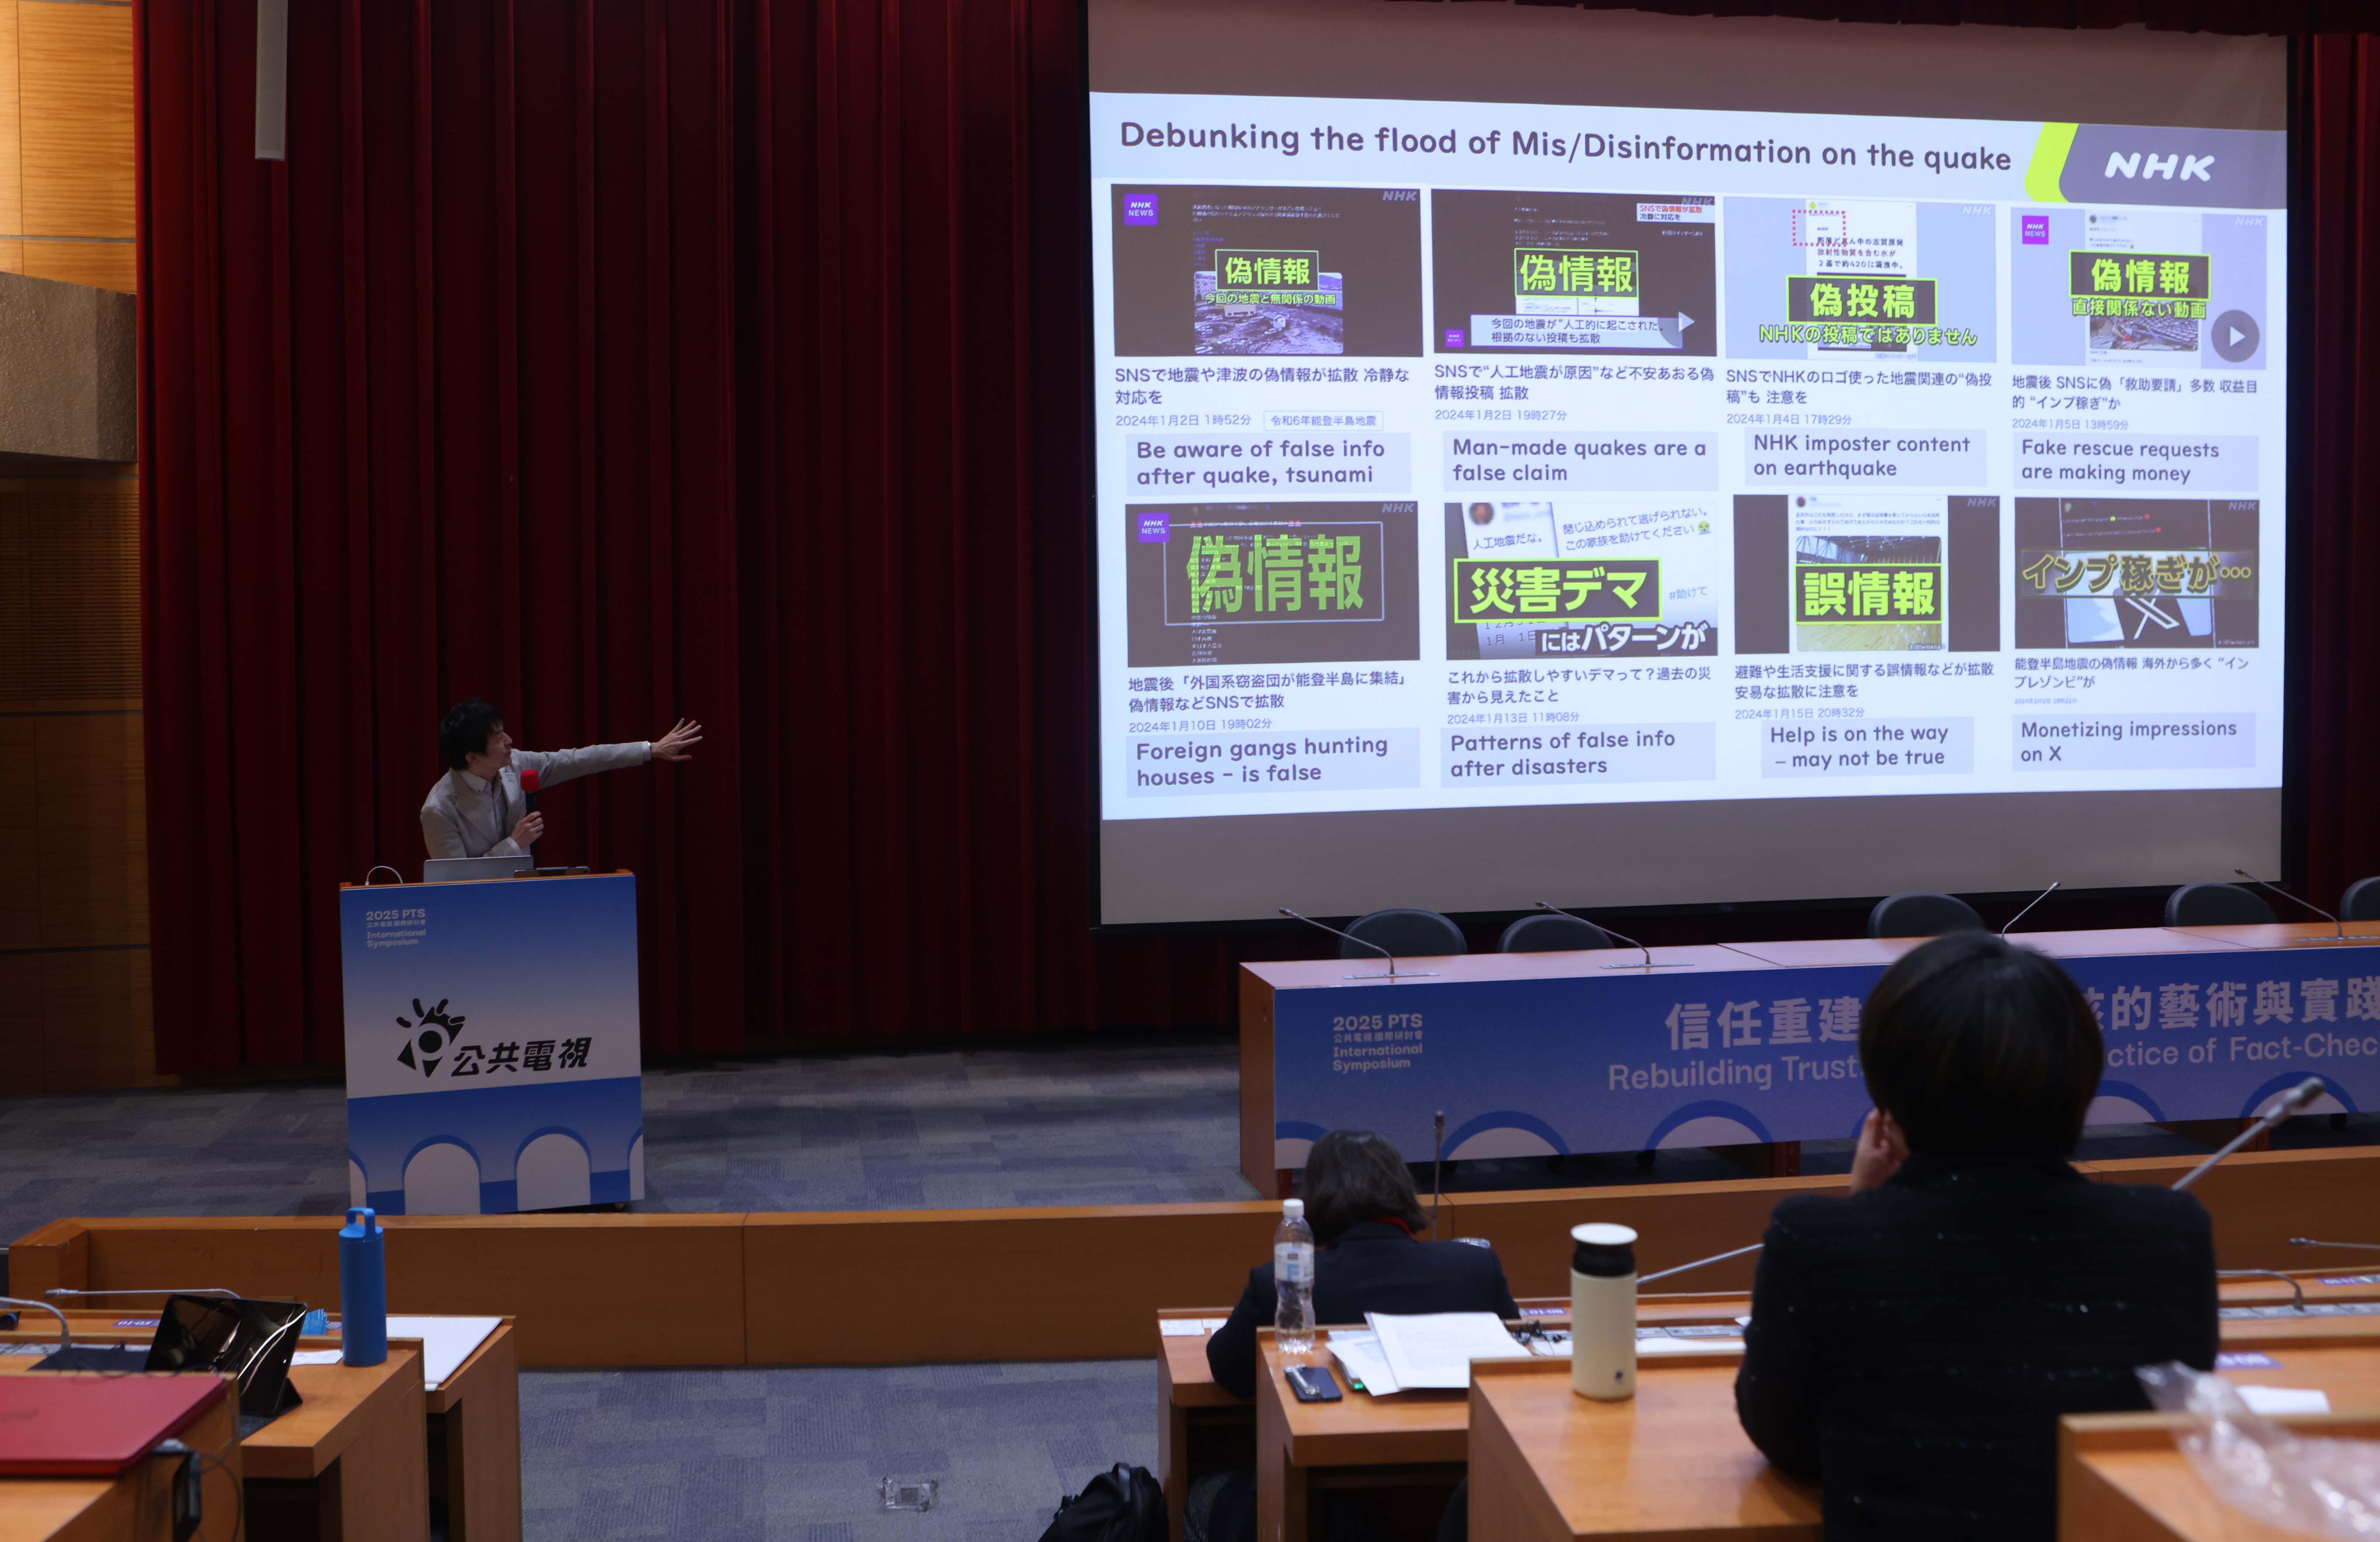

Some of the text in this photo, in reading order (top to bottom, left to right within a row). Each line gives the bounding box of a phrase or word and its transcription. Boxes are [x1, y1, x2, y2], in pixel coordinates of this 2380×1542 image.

[1122, 122, 2011, 174] Debunking the flood of Mis/Disinformation on the quake
[2105, 152, 2215, 181] NHK
[1383, 191, 1416, 201] NHK
[1963, 206, 1993, 216] NHK
[1225, 257, 1310, 285] 偽情報
[1520, 254, 1633, 293] 偽情報
[2092, 259, 2189, 293] 偽情報
[1205, 293, 1336, 305] 今回の地震と無関係の動画
[1810, 283, 1914, 318] 偽投稿
[2072, 298, 2207, 319] 直接関係ない動画
[1491, 333, 1600, 344] 根拠のない投稿も拡散
[1760, 325, 1978, 345] NHKの投稿ではありません
[1115, 368, 1409, 382] SNSで地震や津波の偽情報が拡散 冷静な
[2013, 375, 2051, 389] 地震後
[2191, 379, 2214, 392] 多数
[2220, 380, 2257, 393] 収益目
[1115, 390, 1162, 405] 対応を
[1435, 386, 1528, 400] 情報投稿 拡散
[1767, 390, 1807, 404] 注意を
[2013, 396, 2024, 408] 的
[1116, 415, 1252, 426] 2024年1月2日 1時52分
[1271, 416, 1376, 426] 令和6年能登半島地震
[1436, 410, 1566, 420] 2024年1月2日 19時27分
[1727, 414, 1852, 425] 2024年1月4日 17時29分
[2013, 419, 2128, 430] 2024年1月5日 13時59分
[1138, 440, 1384, 458] Be aware of false info
[1454, 439, 1705, 460] Man-made quakes are a
[1755, 434, 1970, 455] NHK imposter content
[2023, 440, 2219, 461] Fake rescue requests
[1137, 466, 1372, 488] after quake, tsunami
[1453, 464, 1567, 481] false claim
[1754, 460, 1897, 480] on earthquake
[2022, 464, 2190, 484] are making money
[1382, 503, 1414, 513] NHK
[1967, 497, 1997, 507] NHK
[2229, 501, 2257, 510] NHK
[1563, 508, 1708, 534] 閉じ込められて逃げられない。
[1473, 533, 1542, 549] 人工地震だな。
[1566, 525, 1694, 550] この家族を助けてください
[1187, 534, 1364, 613] 偽情報
[1470, 566, 1647, 614] 災害デマ
[1669, 586, 1707, 600] #助けて
[1804, 571, 1935, 616] 誤情報
[1542, 621, 1709, 652] にはパターンが
[1735, 662, 1994, 679] 避難や生活支援に関する誤情報などが拡散
[2015, 657, 2137, 670] 能登半島地震の偽情報
[2142, 657, 2212, 670] 海外から多く
[1448, 689, 1558, 705] 害から見えたこと
[1736, 684, 1858, 699] 安易な拡散に注意を
[1129, 694, 1284, 713] 偽情報などSNSで拡散
[1447, 712, 1579, 724] 2024年1月13日 11時08分
[1735, 708, 1864, 719] 2024年1月15日 20時32分
[1129, 719, 1272, 733] 2024年1月10日 19時02分
[2022, 720, 2236, 740] Monetizing impressions
[1452, 730, 1675, 751] Patterns of false info
[1771, 725, 1948, 747] Help is on the way
[1137, 736, 1387, 762] Foreign gangs hunting
[2021, 746, 2061, 761] on X
[1451, 759, 1607, 777] after disasters
[1793, 750, 1944, 770] may not be true
[1138, 764, 1321, 786] houses is false
[366, 908, 425, 921] 2025 PTS
[367, 929, 426, 939] International
[367, 938, 418, 948] Symposium
[1334, 1013, 1423, 1031] 2025 PTS
[1665, 996, 1862, 1050] 信任重建
[451, 1037, 592, 1076] 公共電視
[1334, 1044, 1422, 1058] International
[1333, 1058, 1410, 1074] Symposium
[1609, 1059, 1771, 1090] Rebuilding
[2189, 1037, 2216, 1063] of
[2230, 1033, 2380, 1061] Fact-Chec
